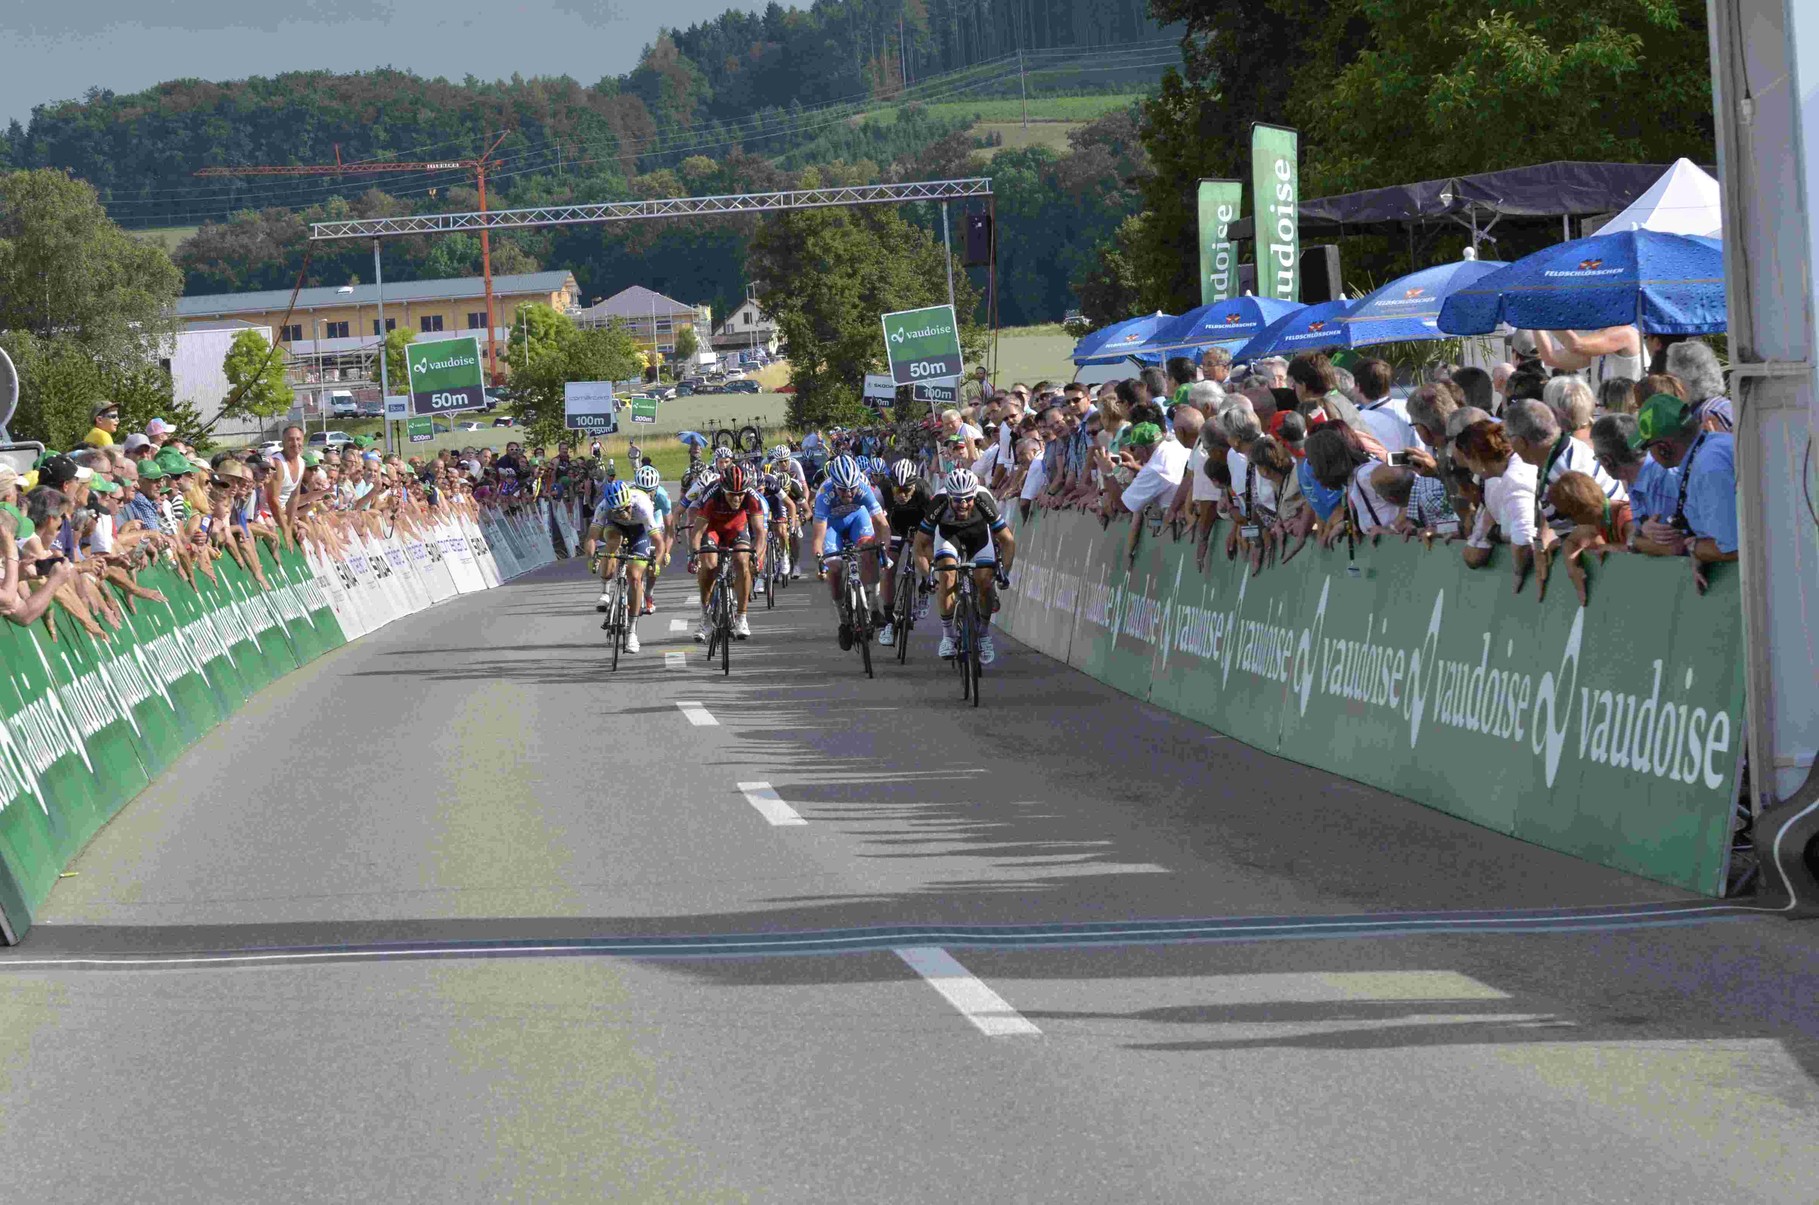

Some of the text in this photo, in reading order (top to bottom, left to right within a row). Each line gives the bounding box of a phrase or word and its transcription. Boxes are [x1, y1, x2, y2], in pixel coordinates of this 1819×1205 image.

[1270, 158, 1295, 302] udoise
[429, 356, 475, 370] vaudoise
[906, 325, 951, 339] vaudoise
[910, 362, 947, 377] 50m
[432, 393, 469, 408] 50m
[576, 416, 605, 426] 100m
[1174, 583, 1224, 661] vaudoise
[1236, 597, 1294, 683] vaudoise
[1321, 613, 1405, 709] vaudoise
[1433, 632, 1531, 742] vaudoise
[1578, 659, 1730, 790] vaudoise
